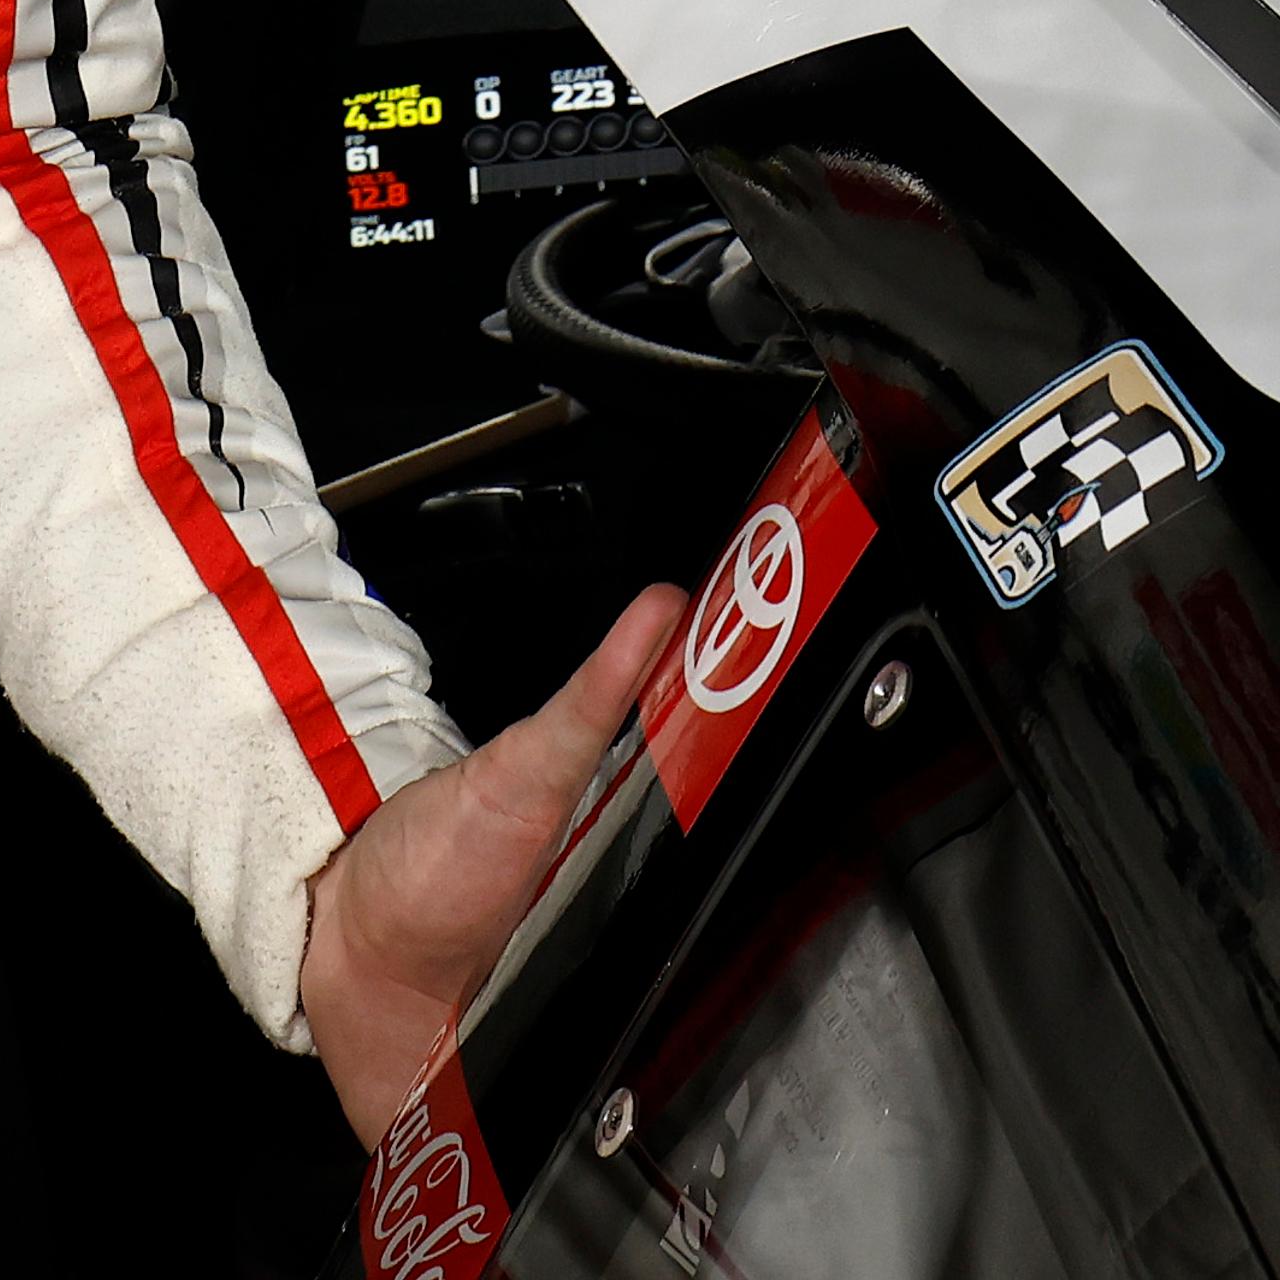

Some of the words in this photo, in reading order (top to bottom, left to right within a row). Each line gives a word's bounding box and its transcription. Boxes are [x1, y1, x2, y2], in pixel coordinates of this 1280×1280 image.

[475, 90, 501, 120] 0
[551, 79, 616, 112] 223
[343, 96, 442, 131] 4.360
[345, 145, 379, 172] 61
[348, 182, 409, 212] 12.8
[350, 218, 435, 248] 6:44:11
